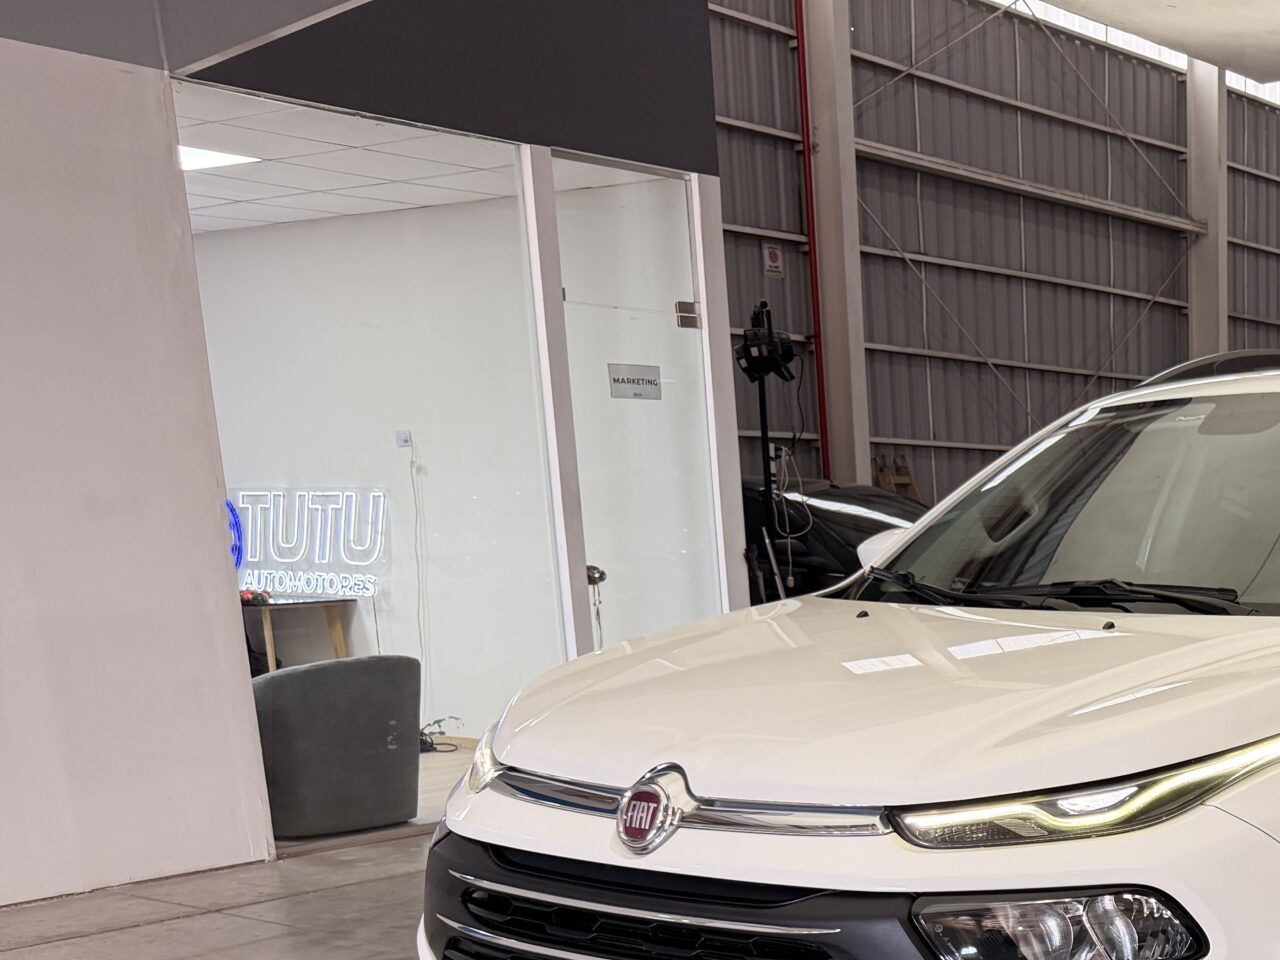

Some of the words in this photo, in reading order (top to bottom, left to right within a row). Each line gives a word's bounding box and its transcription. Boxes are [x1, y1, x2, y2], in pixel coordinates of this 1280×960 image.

[612, 377, 659, 386] MARKETING
[239, 491, 384, 565] TUTU
[241, 569, 378, 597] AUTOMOTORES
[625, 800, 658, 830] FIAT
